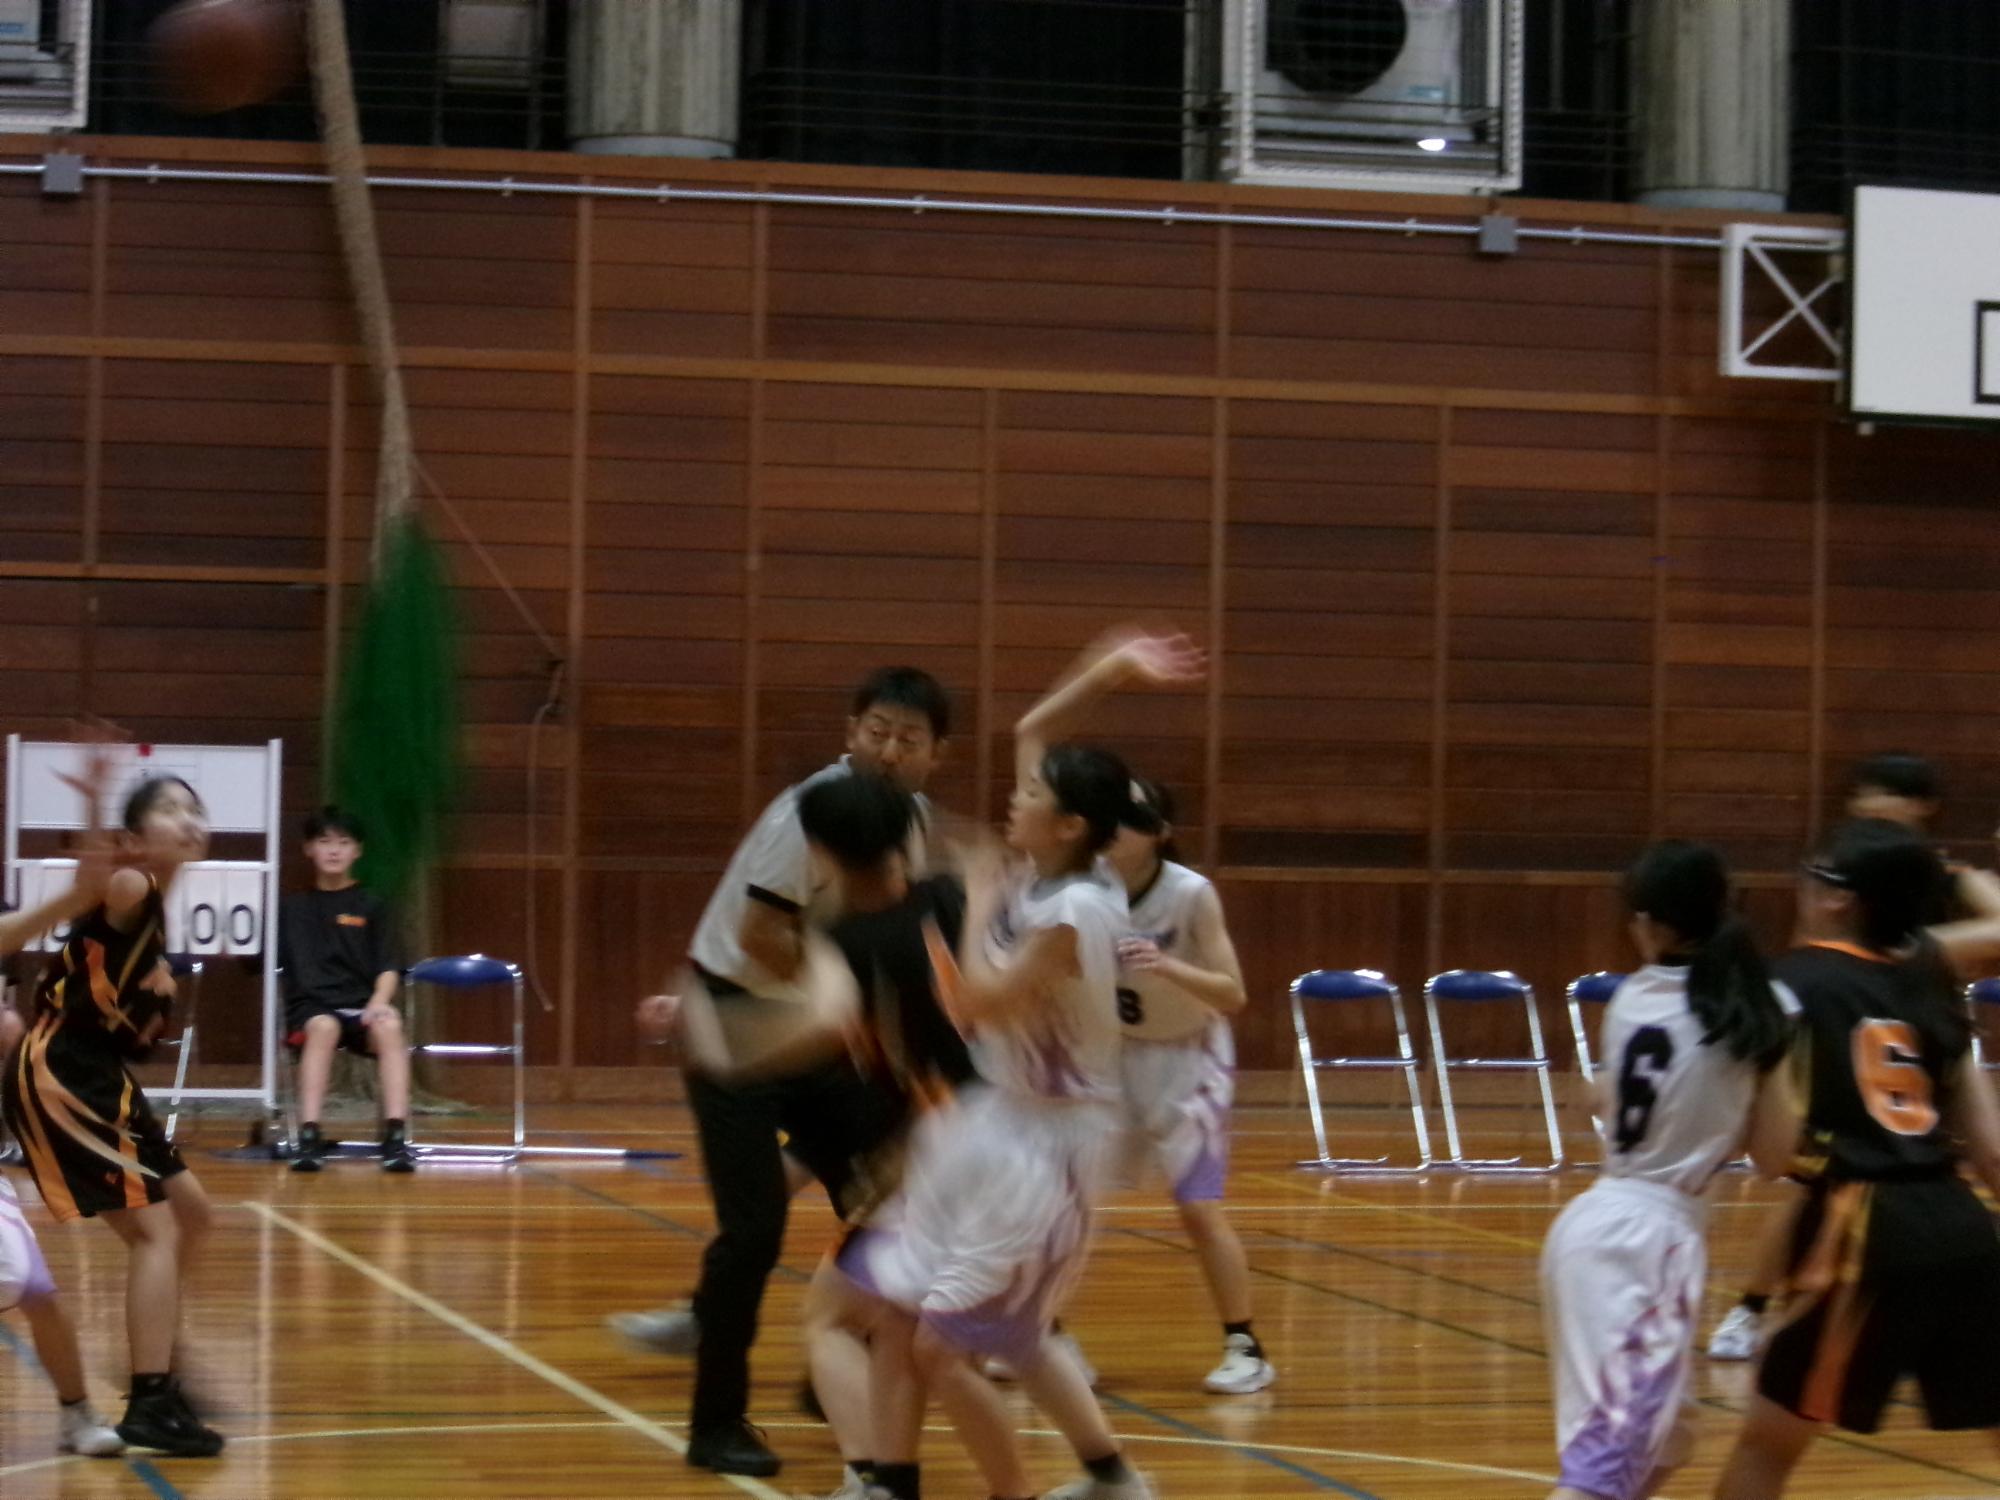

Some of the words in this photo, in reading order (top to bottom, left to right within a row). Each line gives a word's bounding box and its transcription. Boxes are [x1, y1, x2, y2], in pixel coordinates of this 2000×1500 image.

[191, 903, 254, 946] 00
[1615, 1025, 1673, 1154] 6
[1850, 1017, 1939, 1136] 6
